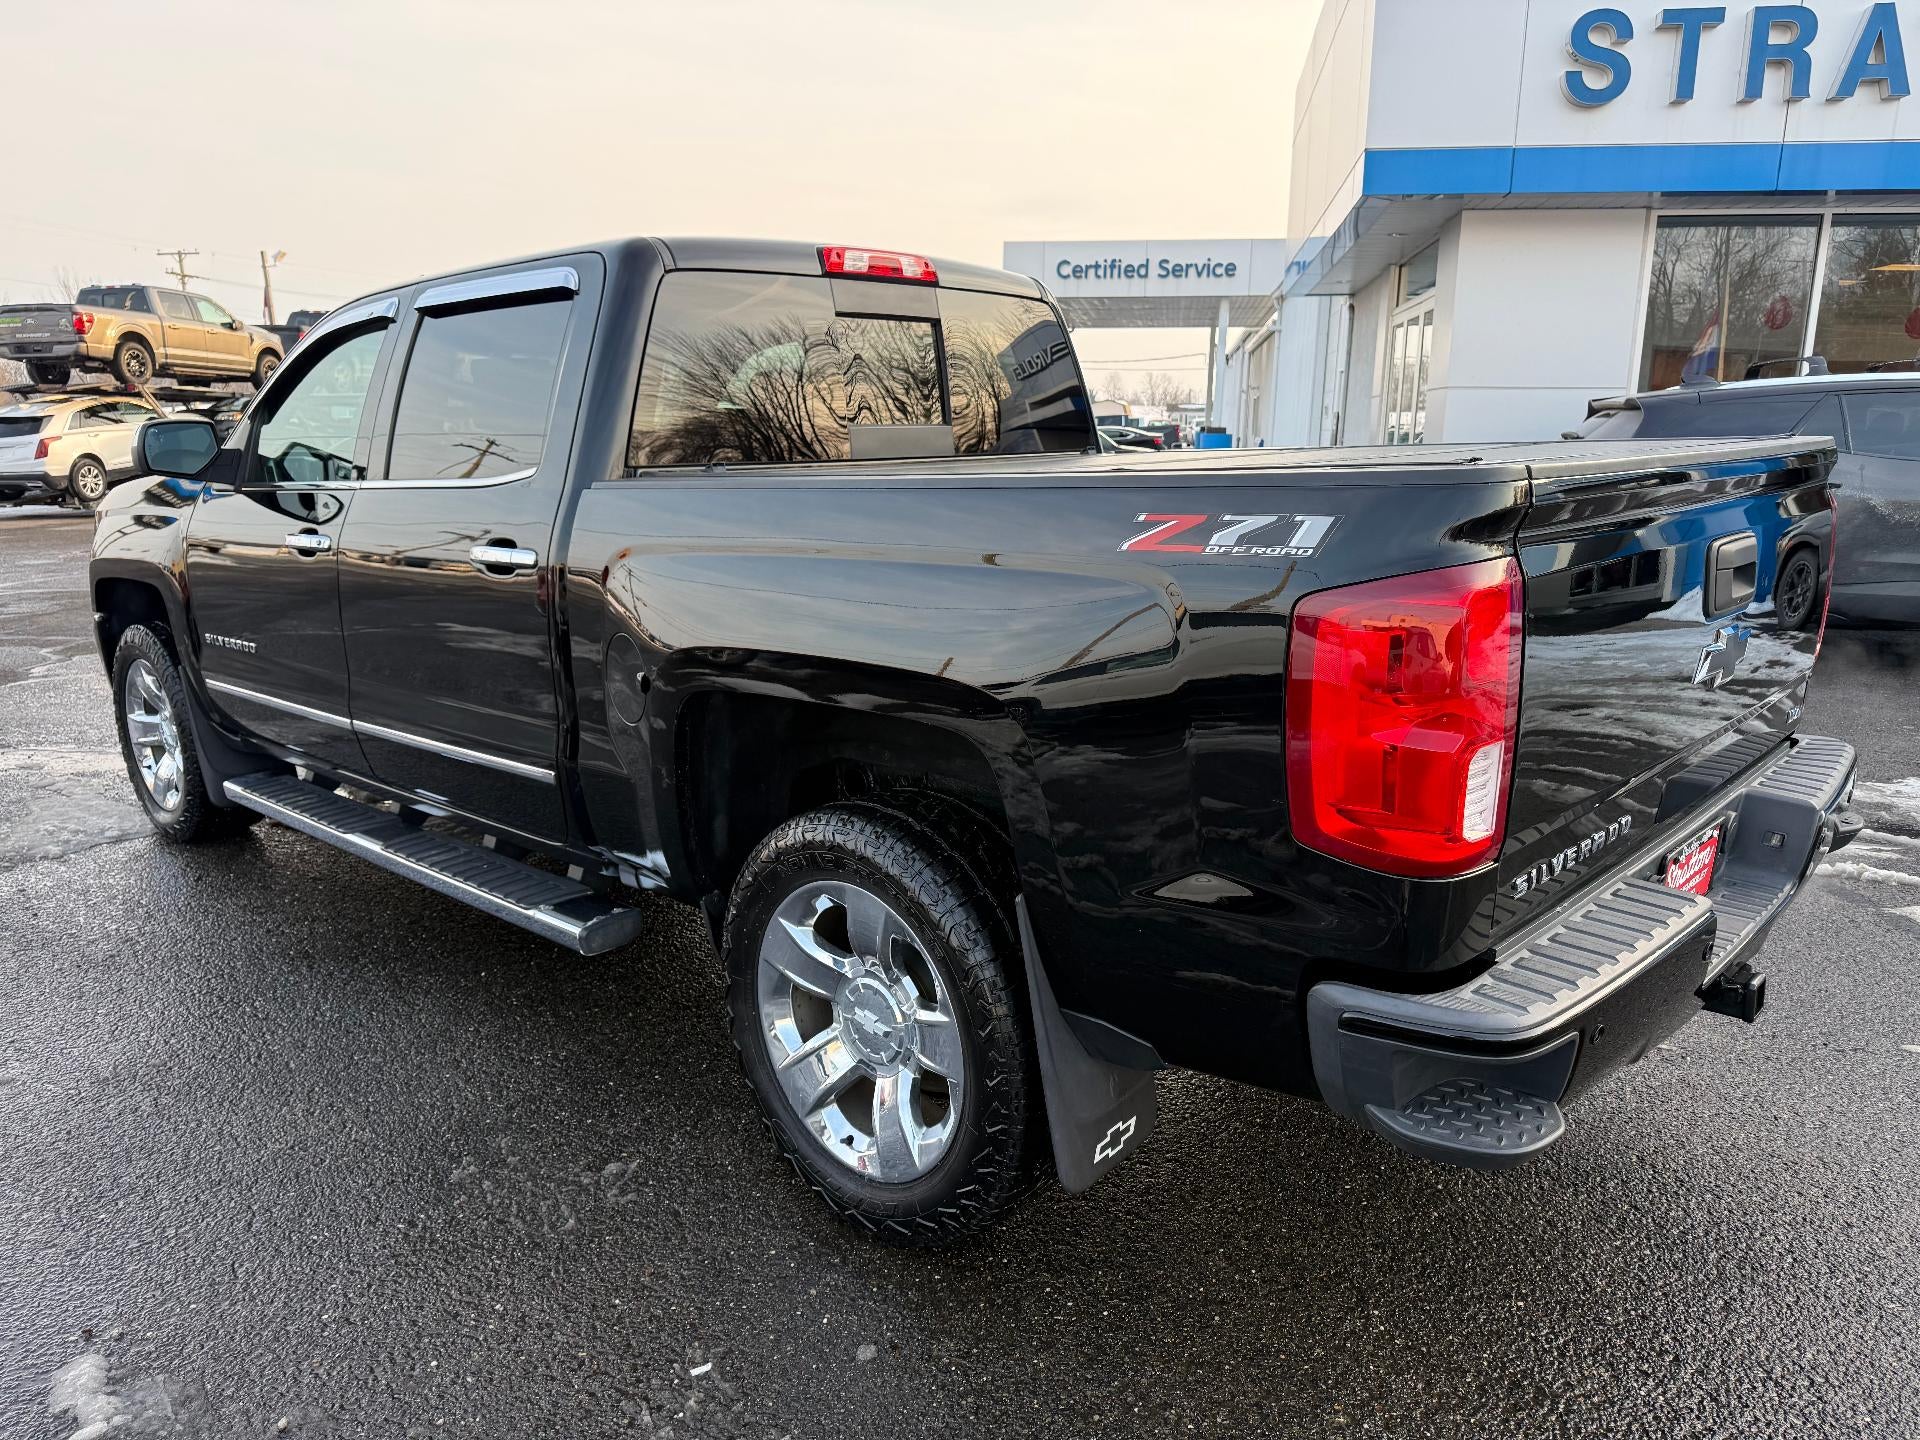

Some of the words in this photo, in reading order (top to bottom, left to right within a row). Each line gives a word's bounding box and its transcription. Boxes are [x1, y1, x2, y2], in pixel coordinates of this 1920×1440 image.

[1560, 2, 1911, 107] STRA
[1056, 259, 1149, 279] Certified
[1157, 257, 1237, 279] Service
[1117, 513, 1342, 552] Z71
[204, 633, 257, 653] SILVERADO
[1511, 814, 1632, 900] SILVERADO
